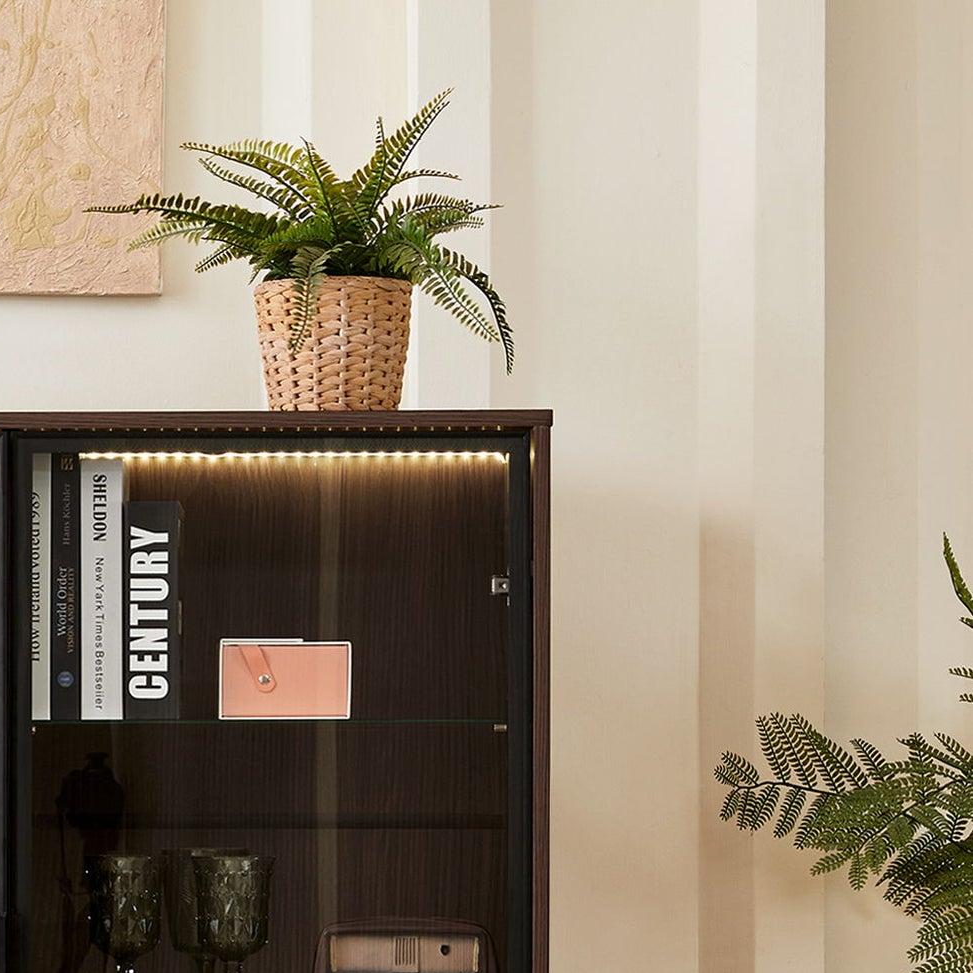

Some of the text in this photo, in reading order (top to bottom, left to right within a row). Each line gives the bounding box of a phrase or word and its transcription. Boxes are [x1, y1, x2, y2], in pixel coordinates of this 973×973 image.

[93, 474, 107, 542] SHELDON
[95, 557, 105, 582] New
[57, 566, 67, 636] World Order
[67, 604, 75, 624] AND
[128, 525, 170, 699] CENTURY
[95, 614, 105, 648] Times
